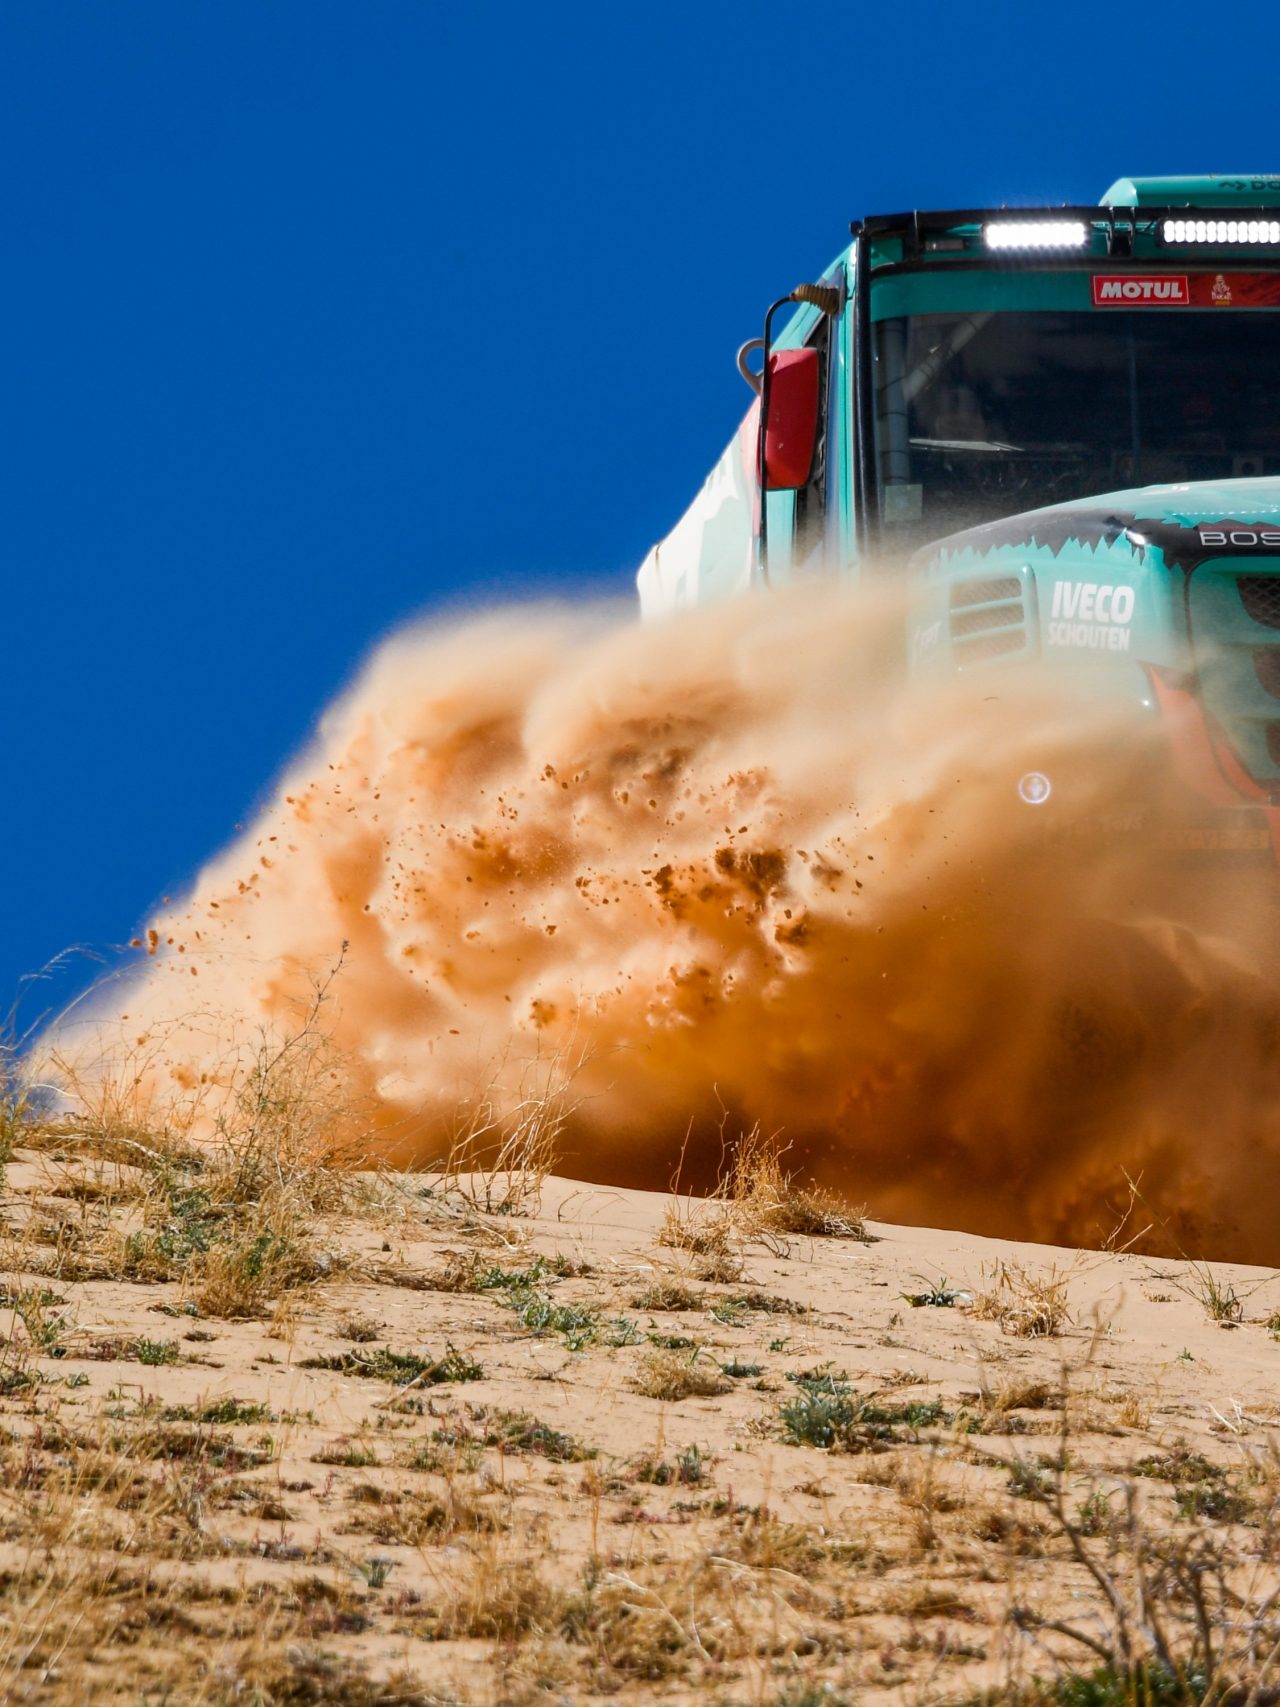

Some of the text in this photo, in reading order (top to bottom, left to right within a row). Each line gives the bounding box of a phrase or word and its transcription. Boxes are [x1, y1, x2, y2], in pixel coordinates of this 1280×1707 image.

[1101, 281, 1182, 299] MOTUL
[1051, 581, 1136, 624] IVECO
[1047, 622, 1131, 651] SCHOUTEN
